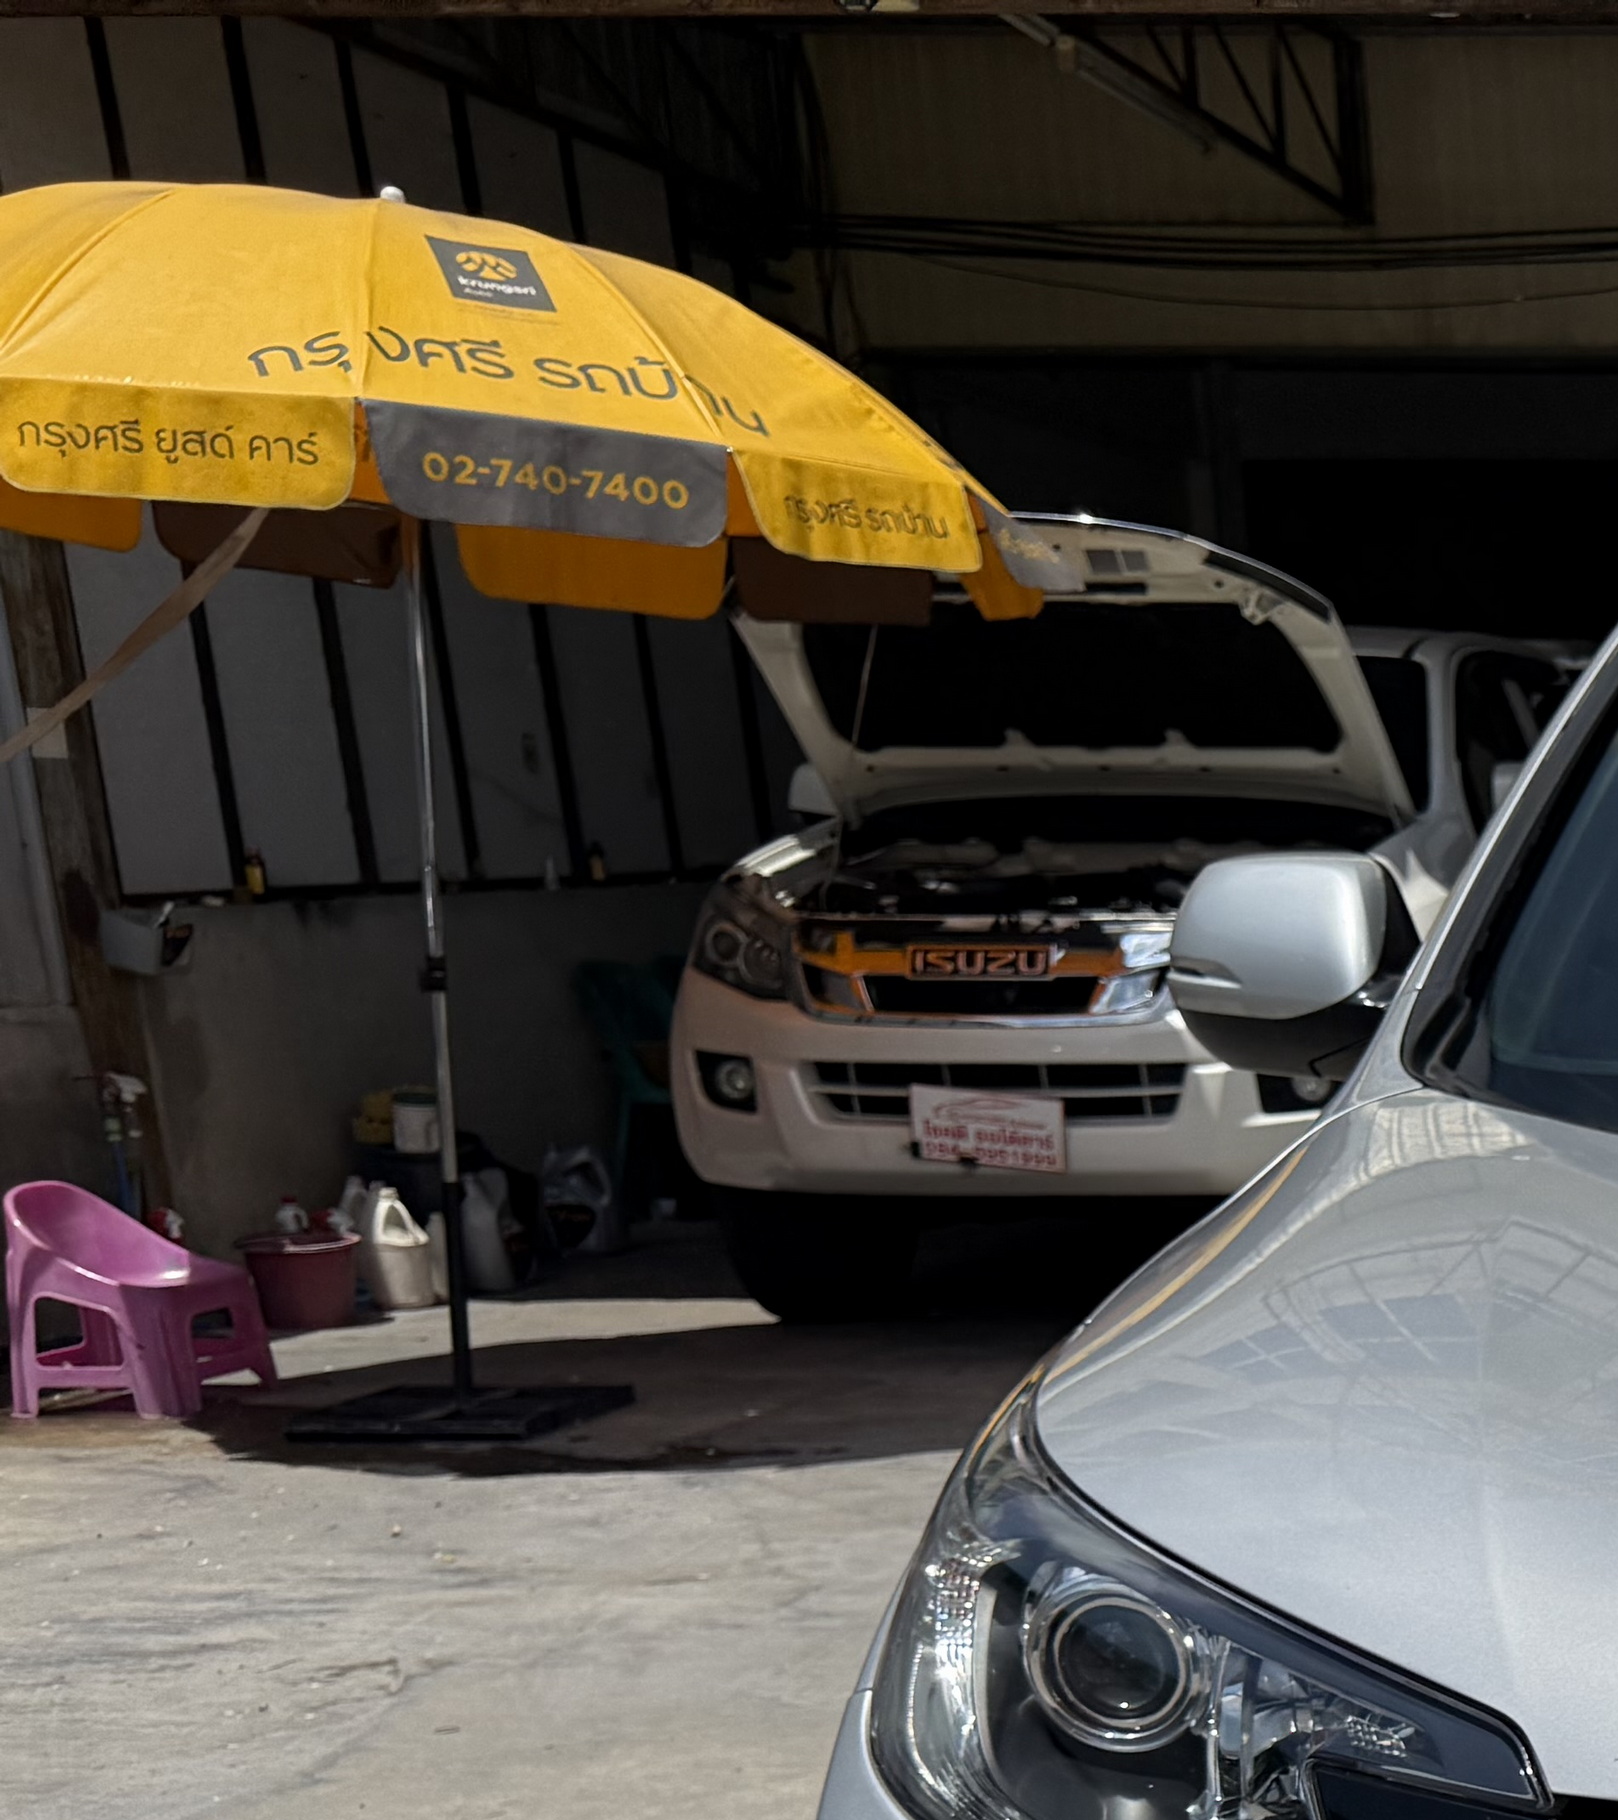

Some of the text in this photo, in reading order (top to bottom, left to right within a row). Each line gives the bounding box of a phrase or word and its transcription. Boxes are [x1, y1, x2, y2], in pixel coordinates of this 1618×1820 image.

[17, 418, 320, 466] กรุงศรี ยูสด์ คาร์
[421, 450, 690, 510] 02-740-7400
[914, 950, 1047, 976] ISUZU
